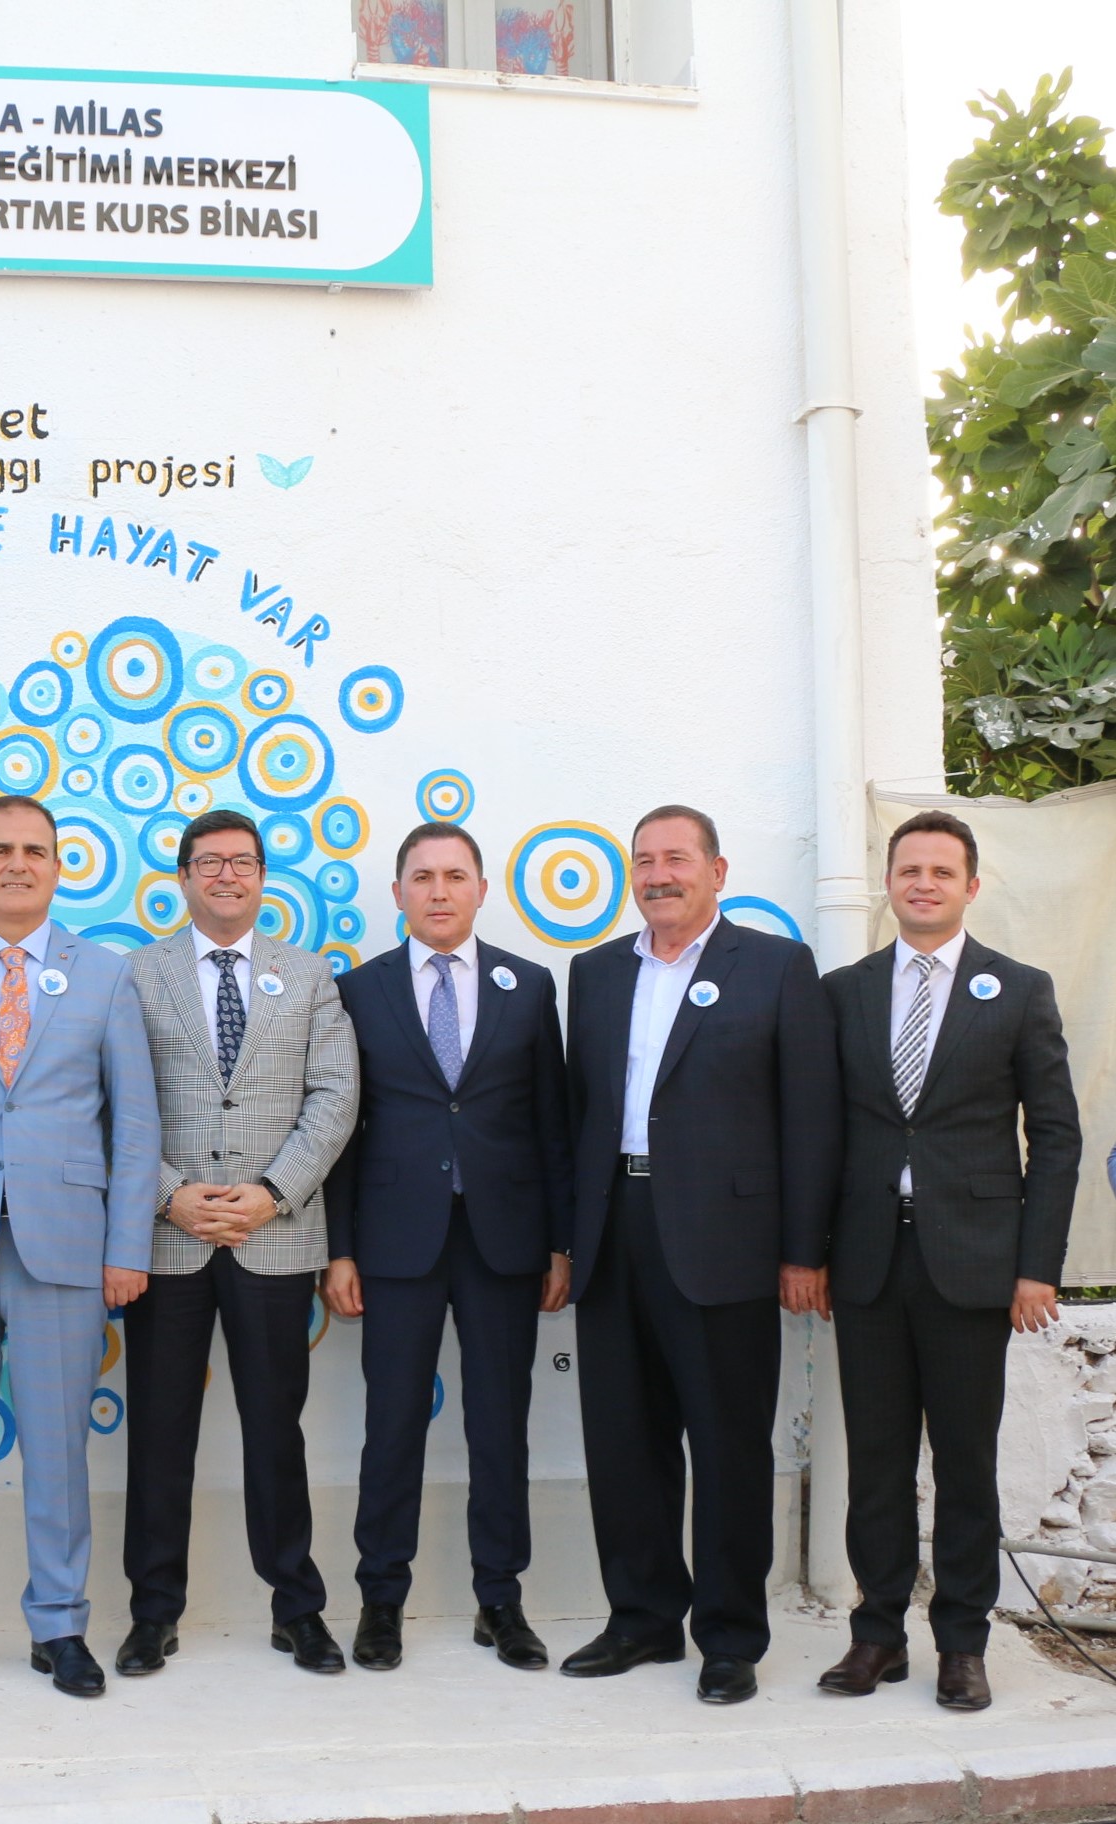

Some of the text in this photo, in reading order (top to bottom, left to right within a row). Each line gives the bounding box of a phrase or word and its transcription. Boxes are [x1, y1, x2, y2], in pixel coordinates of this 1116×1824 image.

[54, 99, 164, 138] MİLAS
[143, 153, 297, 191] MERKEZİ
[96, 202, 189, 235] KURS
[200, 199, 318, 240] BİNASI
[88, 455, 236, 498] projesi
[49, 512, 222, 583] HAYAT
[240, 568, 332, 668] VAR
